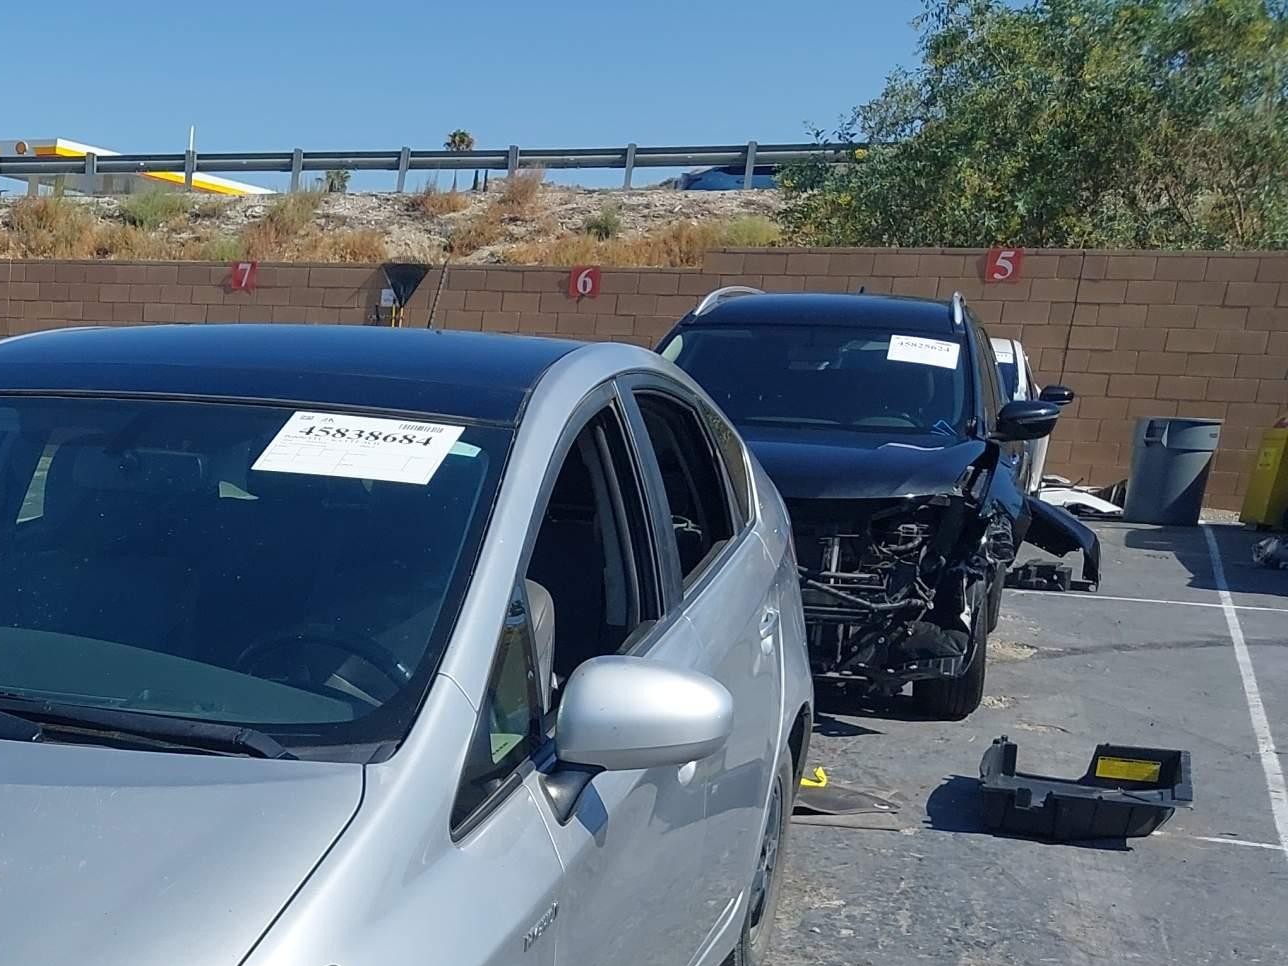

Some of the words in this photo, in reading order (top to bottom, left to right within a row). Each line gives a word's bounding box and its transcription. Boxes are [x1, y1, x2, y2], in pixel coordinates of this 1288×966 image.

[238, 263, 252, 288] 7
[992, 250, 1015, 280] 5
[576, 267, 593, 294] 6
[298, 425, 433, 446] 45838684
